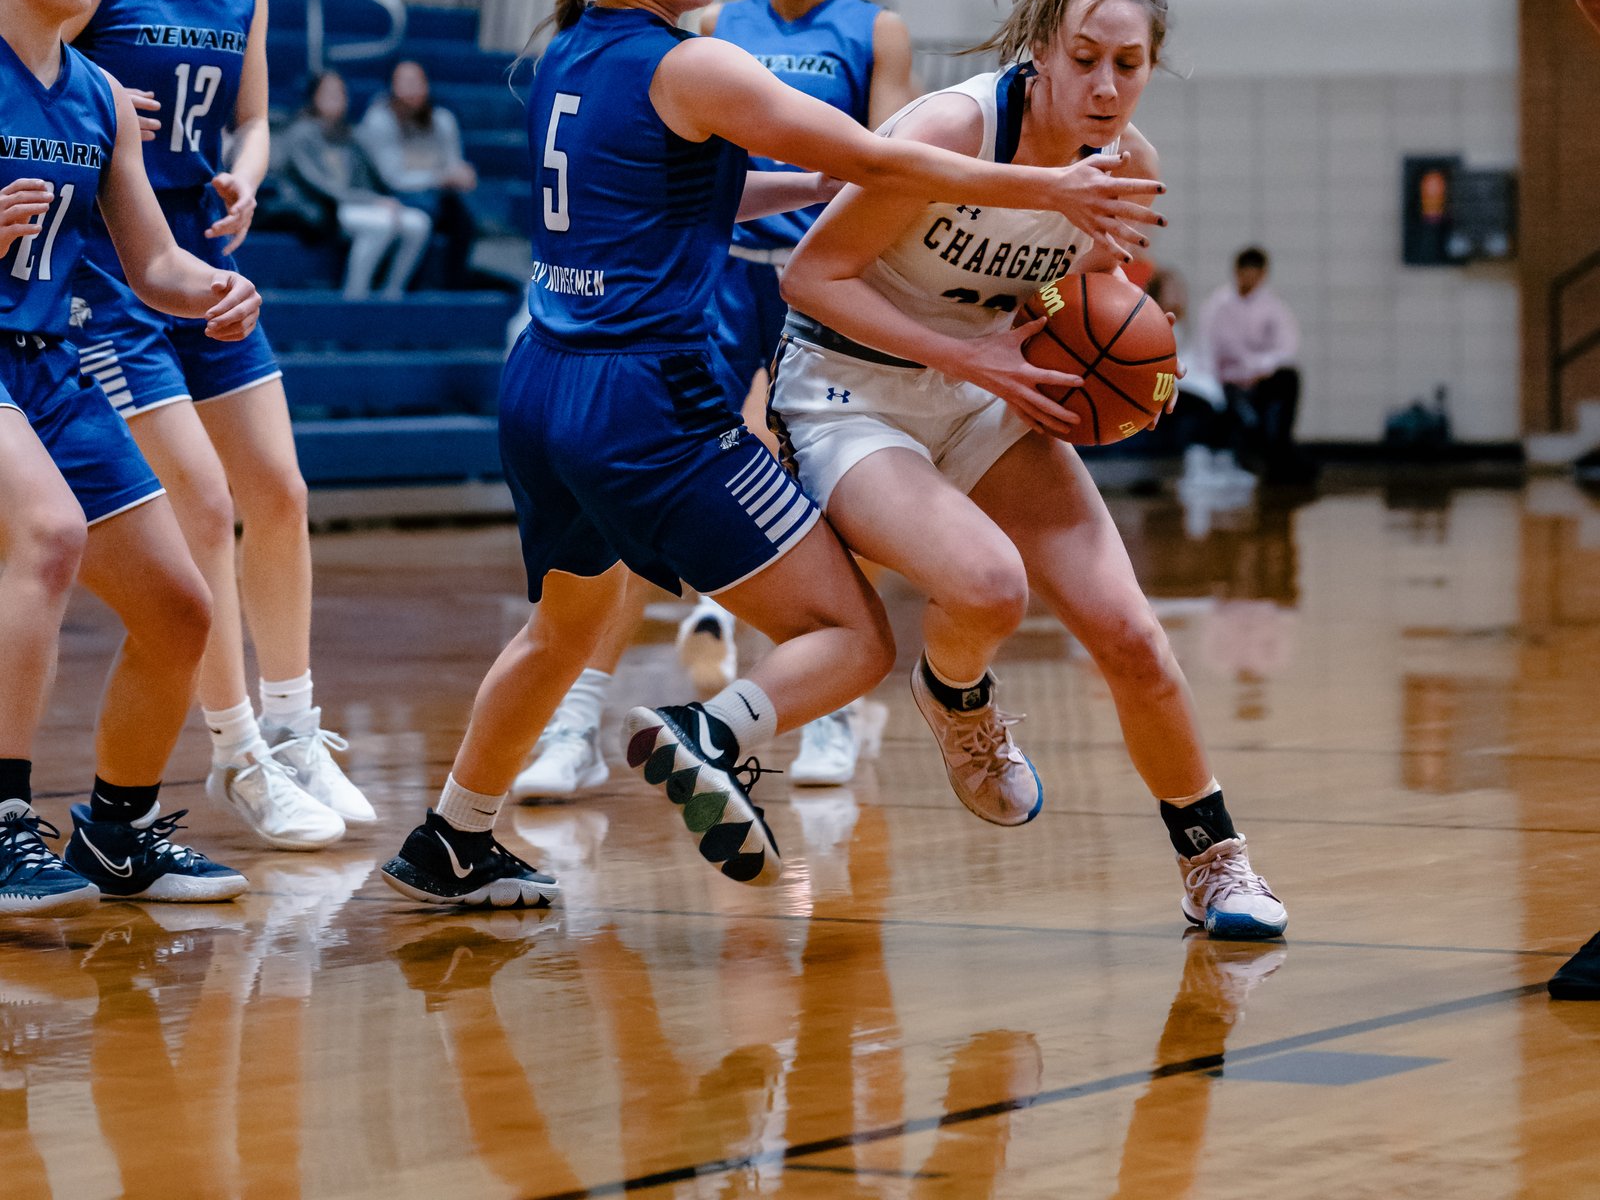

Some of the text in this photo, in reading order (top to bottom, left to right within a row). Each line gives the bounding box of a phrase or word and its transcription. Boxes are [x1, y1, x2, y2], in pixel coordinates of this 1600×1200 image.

[135, 24, 246, 55] NEWARK
[170, 63, 223, 152] 12
[0, 135, 101, 169] NEWARK
[543, 92, 581, 232] 5
[923, 216, 1077, 283] CHARGERS
